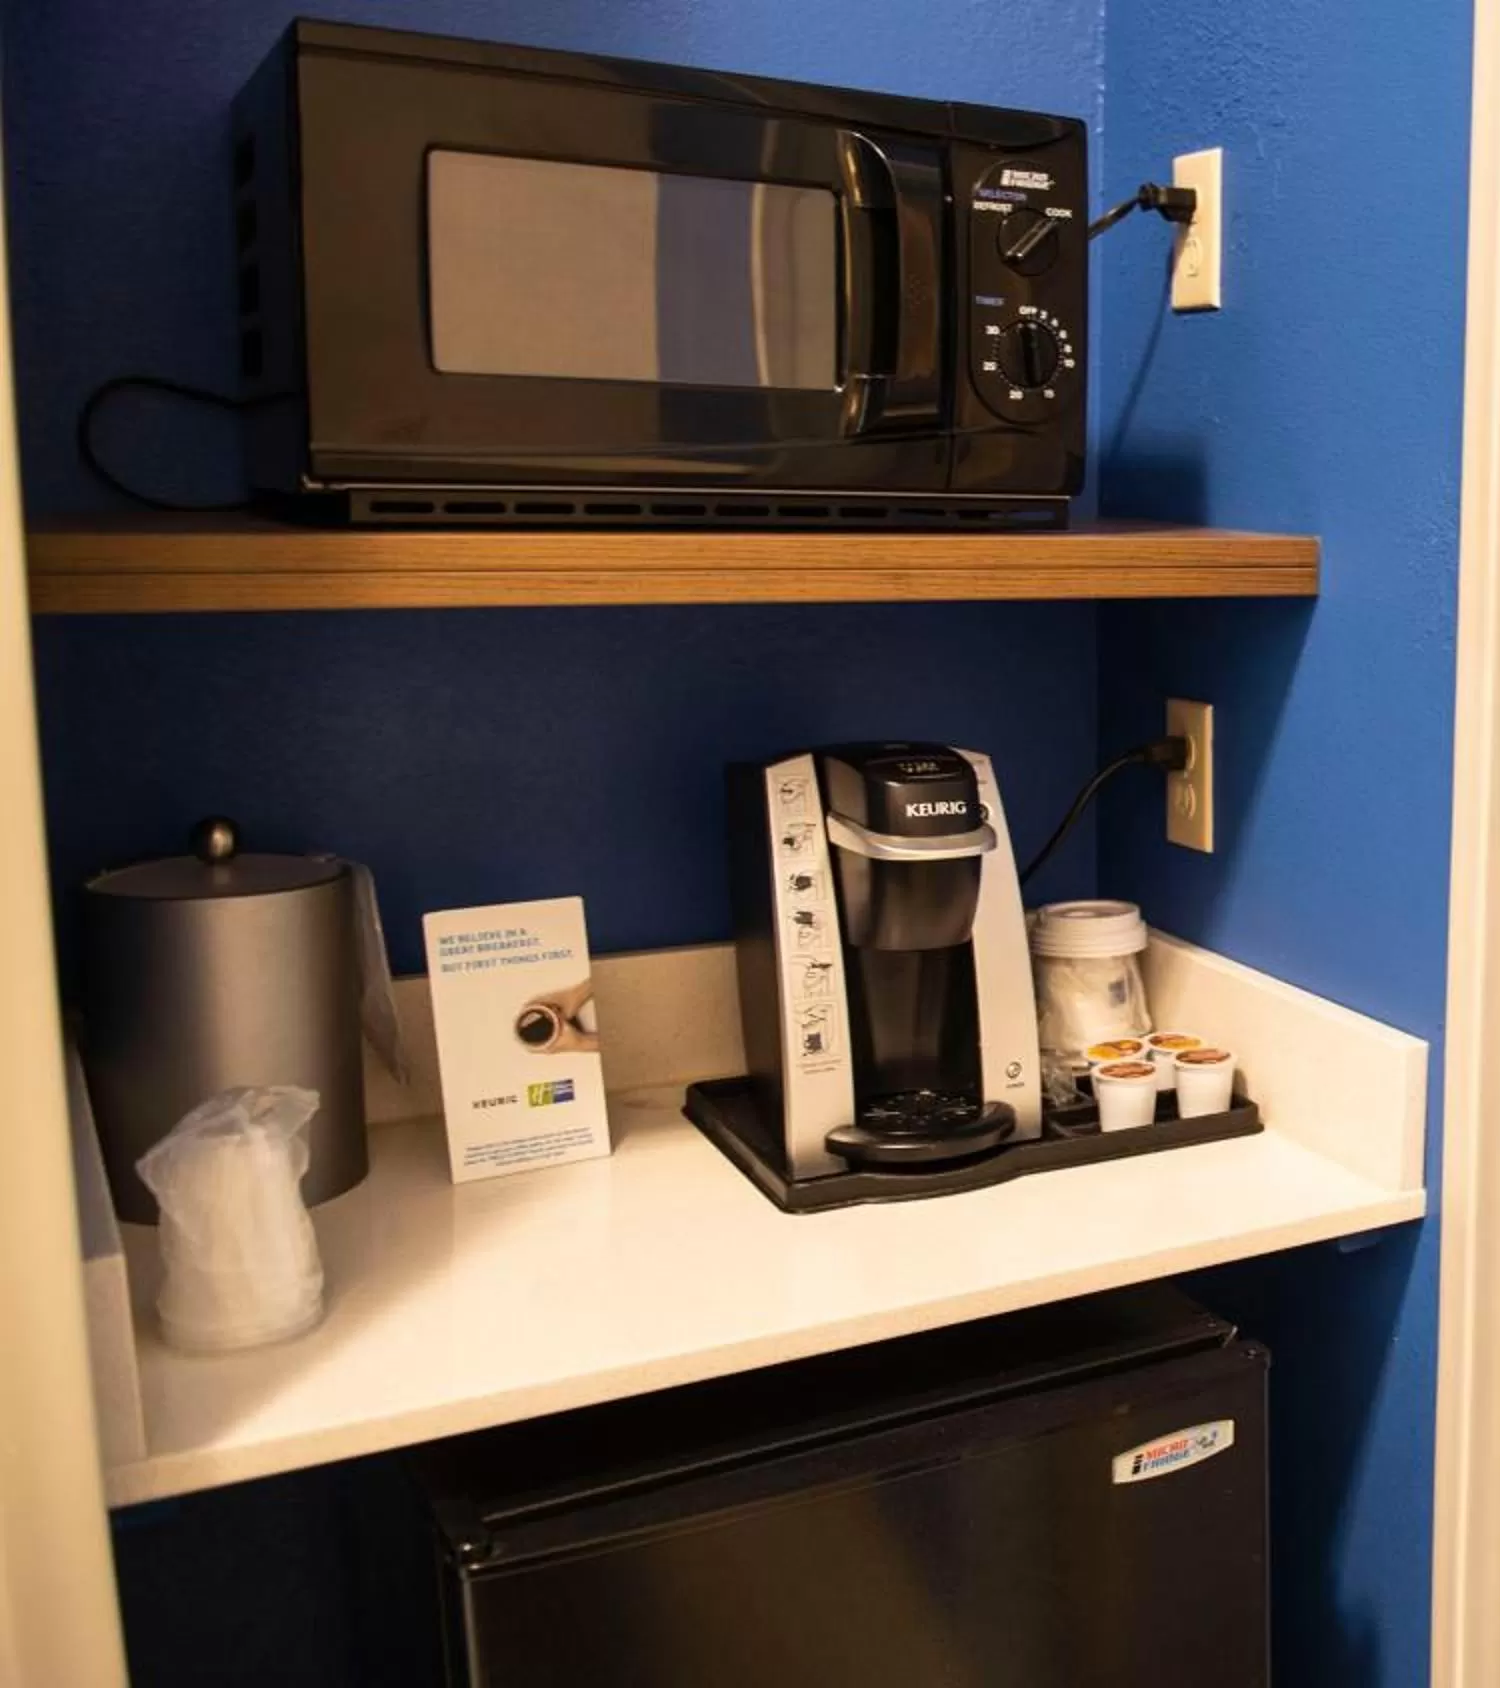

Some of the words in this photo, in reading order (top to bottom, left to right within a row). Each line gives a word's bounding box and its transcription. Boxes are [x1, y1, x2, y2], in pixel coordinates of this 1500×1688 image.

[1045, 207, 1072, 218] COOK
[1018, 305, 1038, 315] OFF
[905, 801, 968, 818] KEURIG
[472, 1094, 518, 1109] KEURIG
[1145, 1439, 1189, 1459] MICRO
